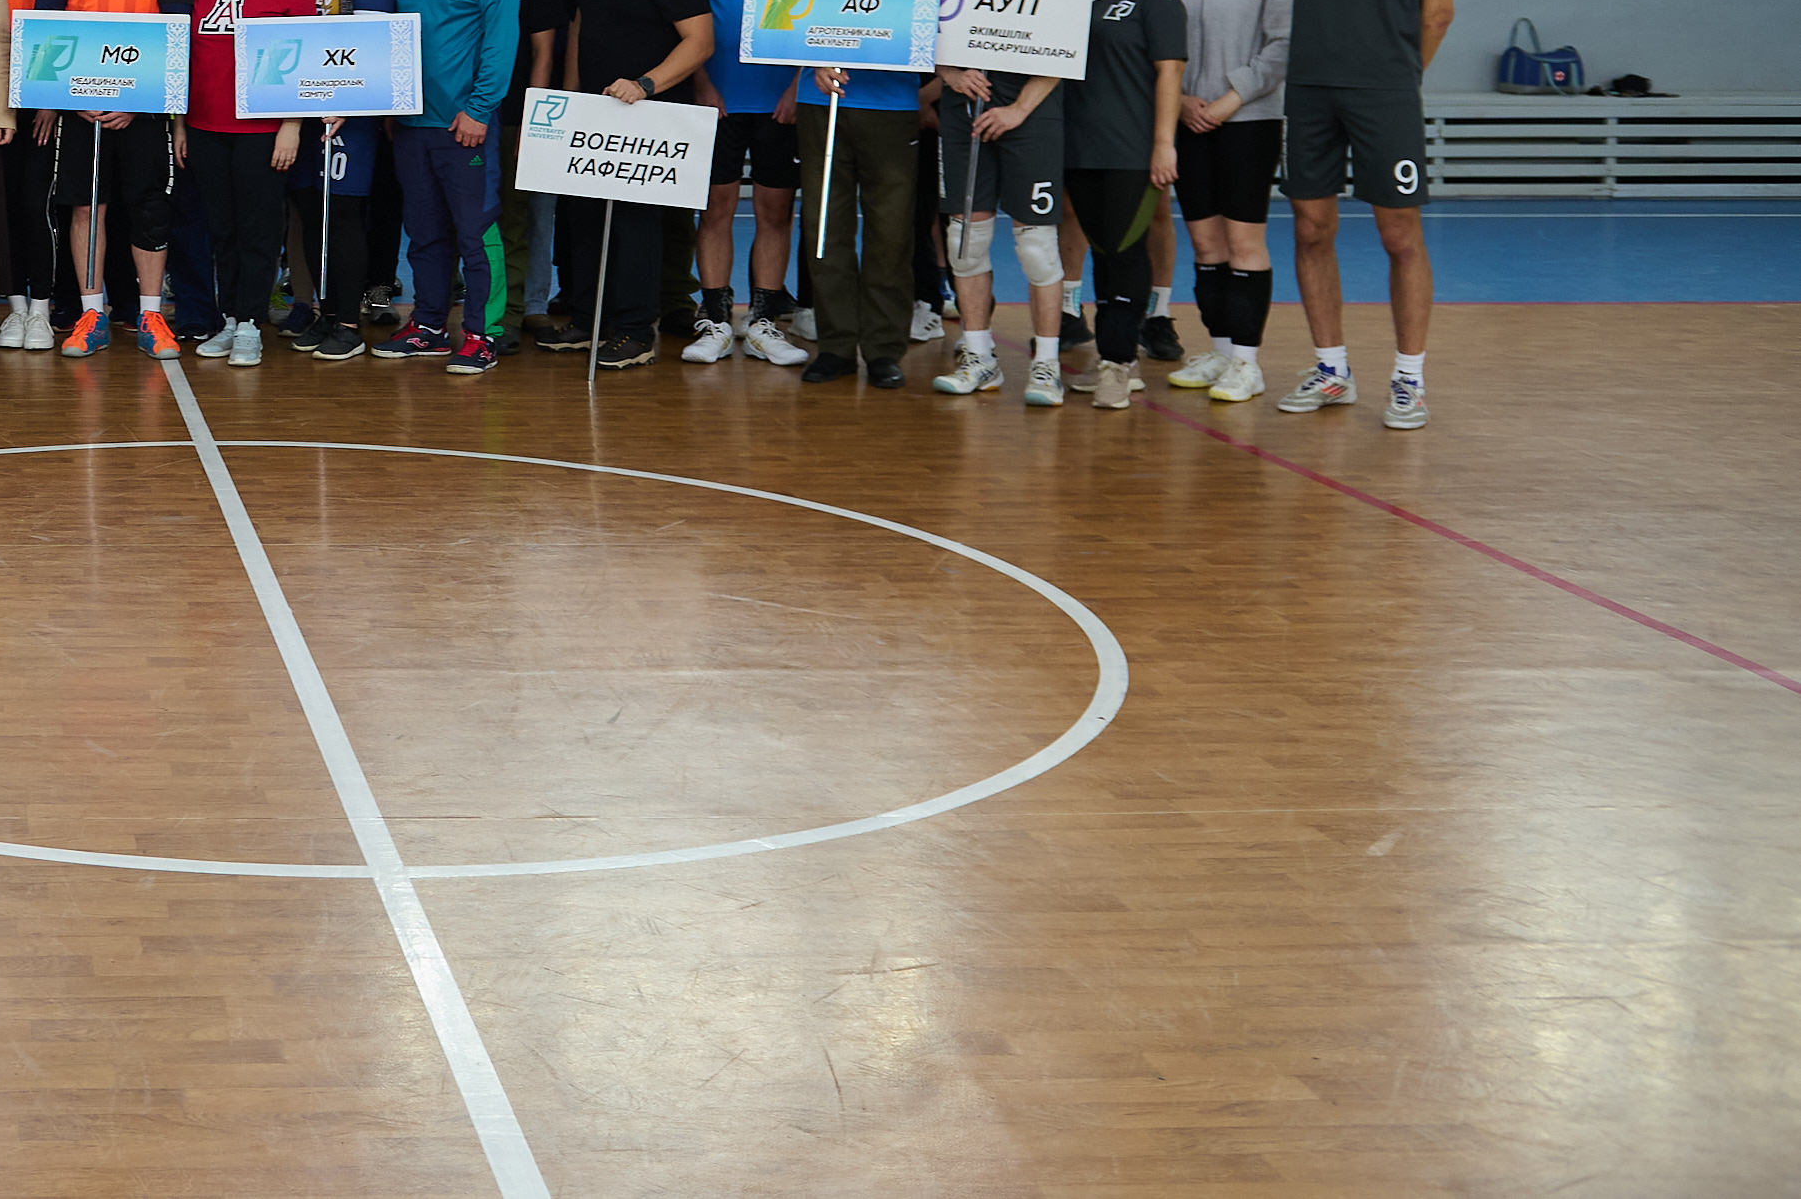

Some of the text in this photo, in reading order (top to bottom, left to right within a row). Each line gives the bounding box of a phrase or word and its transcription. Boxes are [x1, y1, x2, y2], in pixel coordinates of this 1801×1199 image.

[806, 38, 860, 47] ФАКУЛЬТЕТІ
[969, 26, 1033, 41] ӘКІМШІЛІК
[101, 45, 139, 64] МФ
[968, 40, 1077, 59] БАСҚАРУШЫЛАРЫ
[70, 88, 120, 97] ФАКУЛЬТЕТІ
[298, 91, 333, 100] кампус
[570, 131, 689, 160] ВОЕННАЯ
[567, 156, 677, 186] КАФЕДРА
[1394, 159, 1419, 195] 9
[1030, 181, 1054, 215] 5
